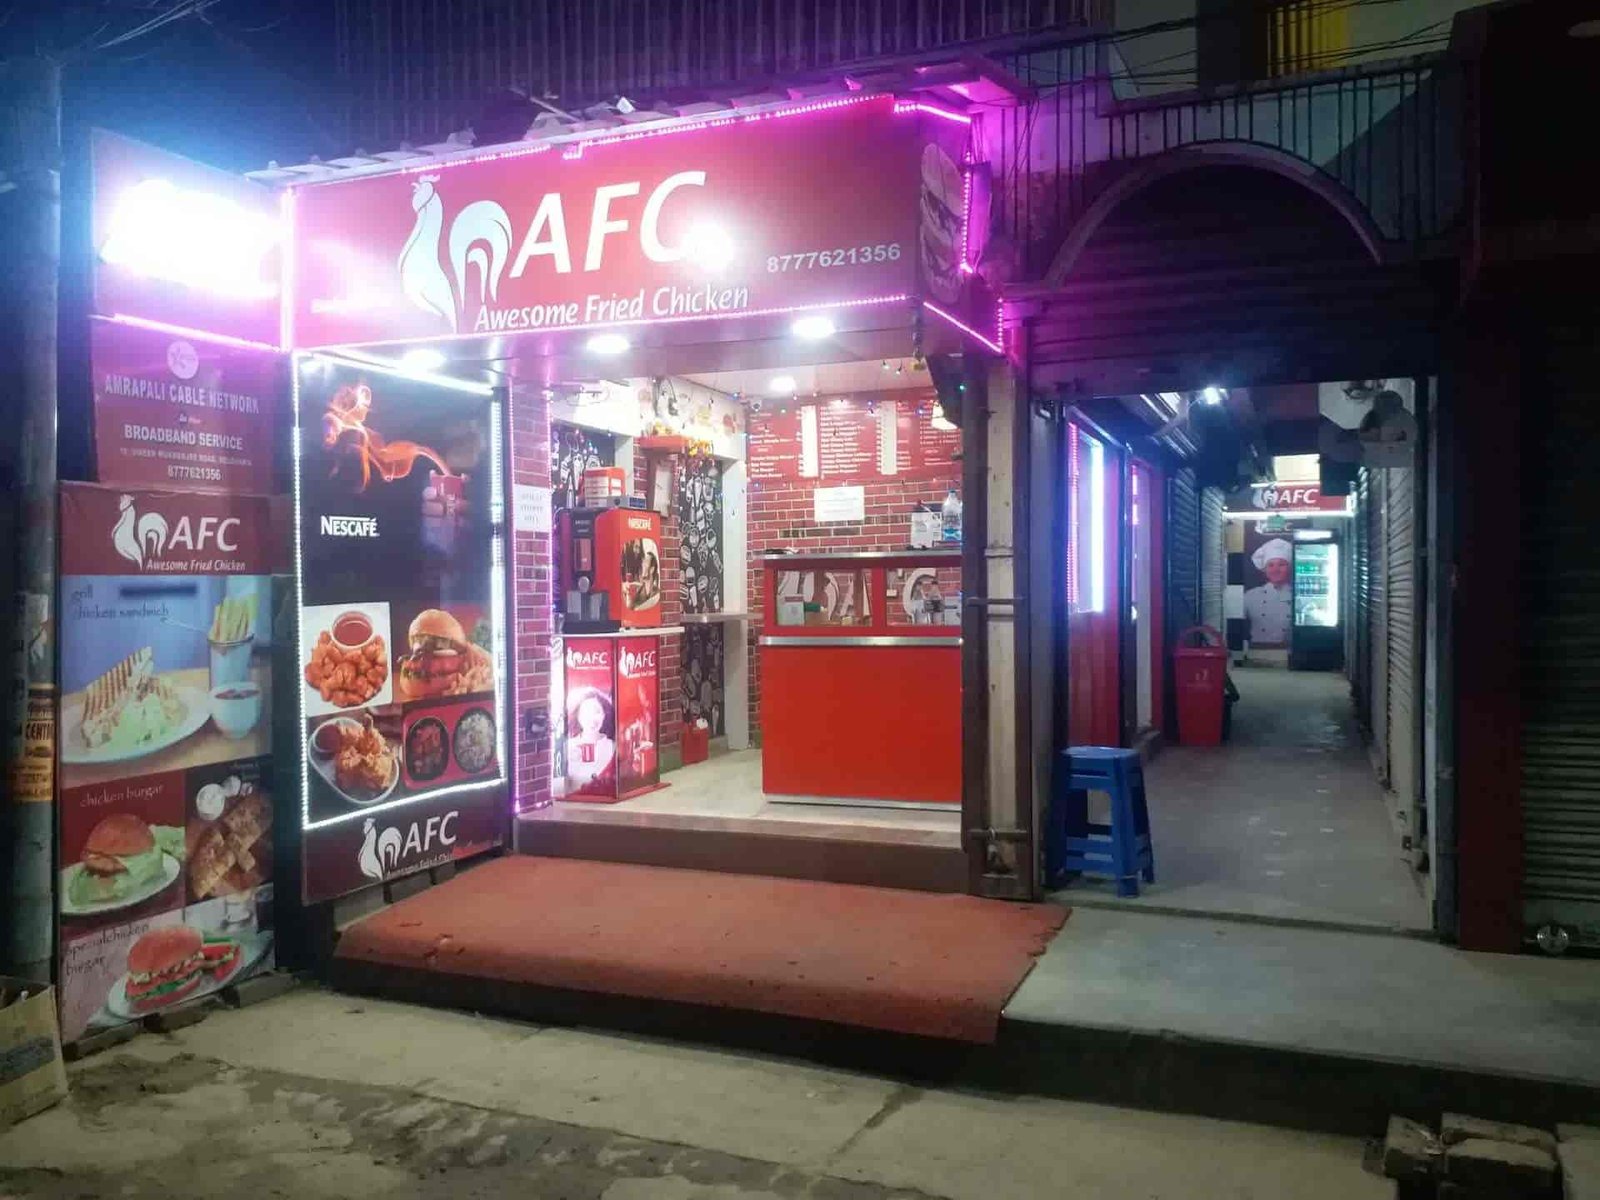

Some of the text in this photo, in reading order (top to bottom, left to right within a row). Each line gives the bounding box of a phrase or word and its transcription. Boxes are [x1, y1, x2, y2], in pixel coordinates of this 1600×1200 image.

[509, 171, 707, 279] AFC
[766, 243, 901, 273] 8777621356
[474, 283, 749, 332] Awesome Fried Chicken
[105, 373, 260, 414] AMRAPALI CABLE NETWORK
[124, 424, 243, 450] BROADBAND SERVICE
[1278, 488, 1319, 504] AFC
[168, 515, 241, 551] AFC
[320, 514, 380, 538] NESCAFÉ
[146, 558, 246, 572] Awesome Fried Chicken
[582, 651, 609, 664] AFC
[634, 650, 656, 669] AFC
[402, 811, 459, 858] AFC
